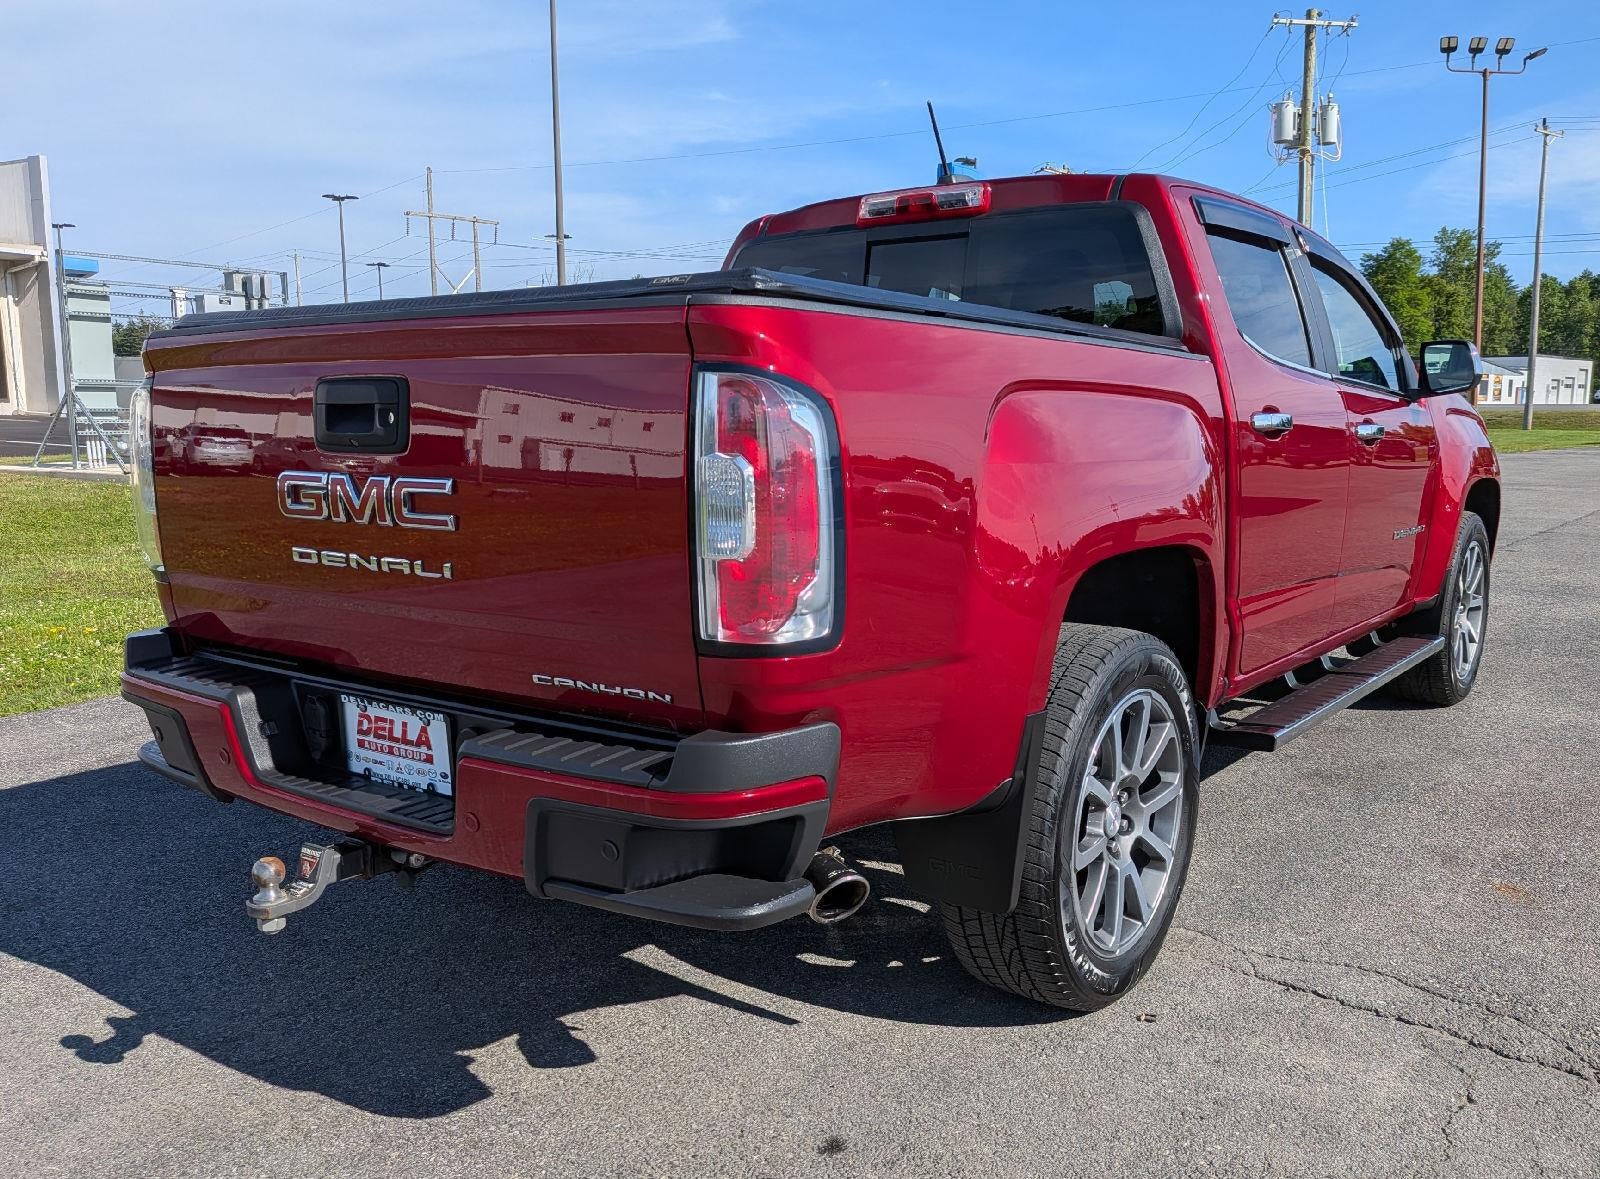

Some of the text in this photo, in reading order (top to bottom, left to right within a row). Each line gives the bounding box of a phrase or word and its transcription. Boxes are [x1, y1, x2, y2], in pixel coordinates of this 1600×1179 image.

[652, 275, 688, 285] GMC
[277, 470, 456, 532] GMC
[291, 546, 452, 580] DENALI
[532, 674, 671, 704] CANYON
[341, 694, 444, 722] DELLACARS.COM
[356, 711, 433, 751] DELLA
[363, 740, 427, 760] AUTO GROUP
[927, 856, 984, 881] GMC
